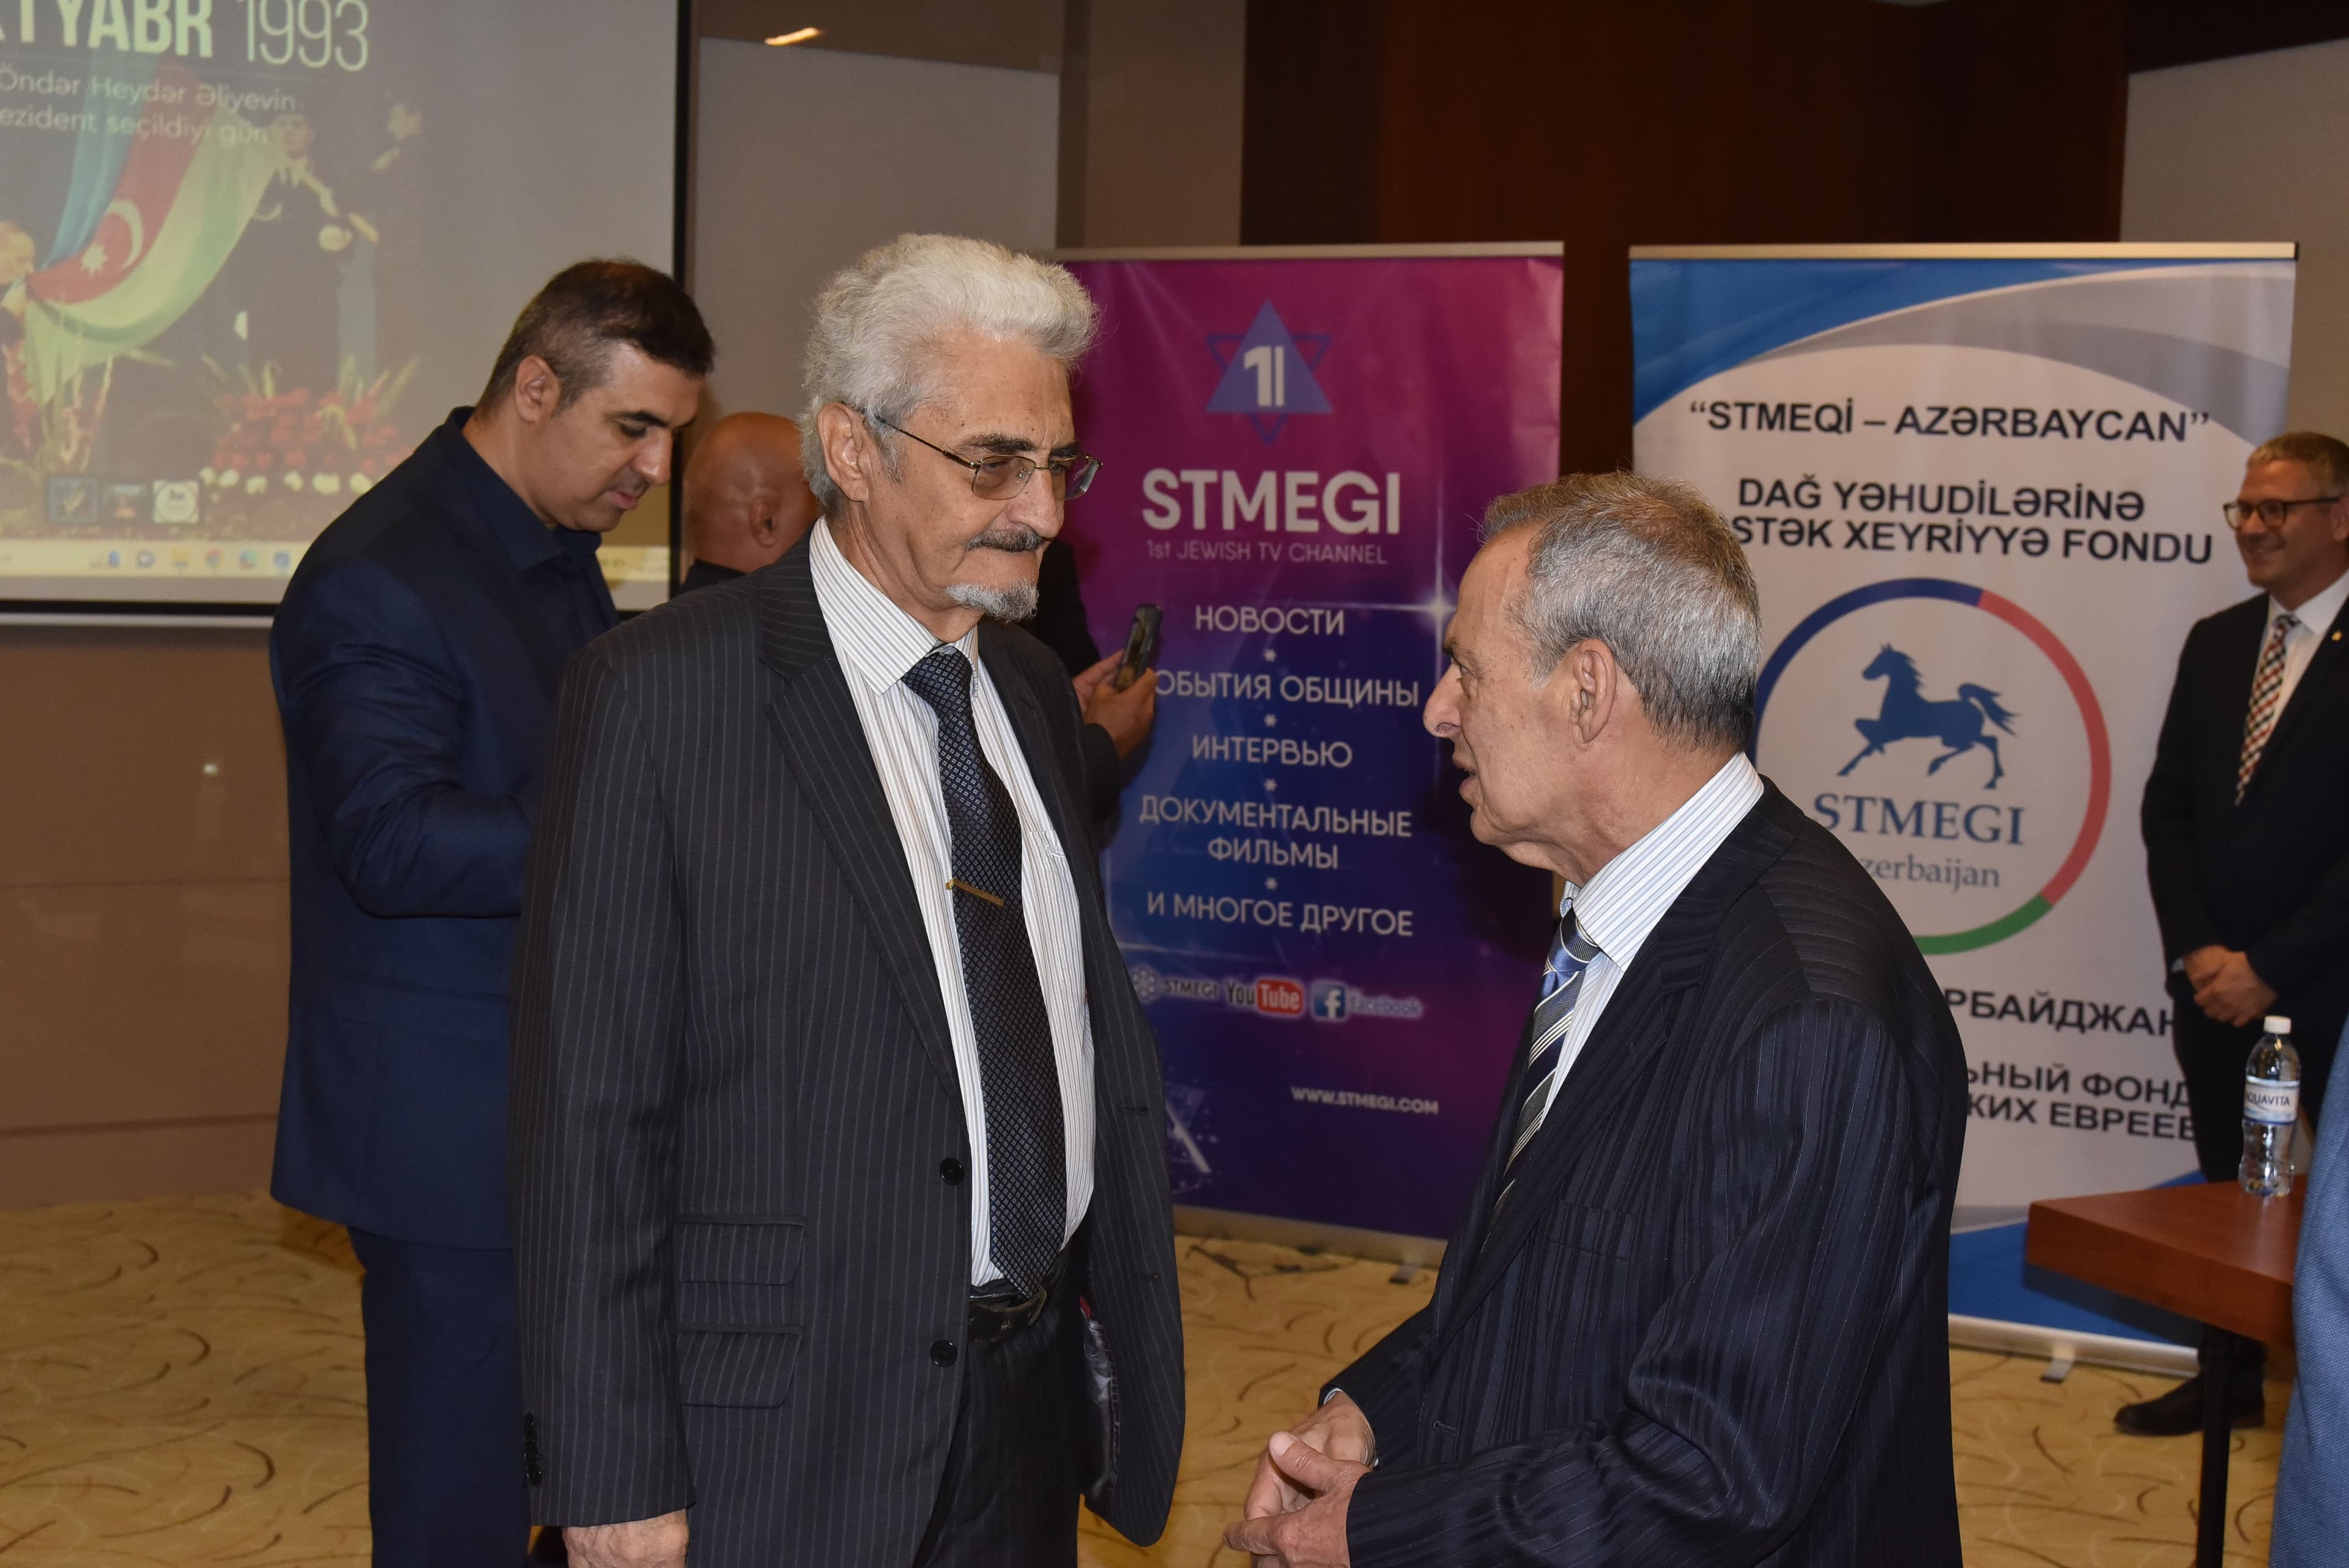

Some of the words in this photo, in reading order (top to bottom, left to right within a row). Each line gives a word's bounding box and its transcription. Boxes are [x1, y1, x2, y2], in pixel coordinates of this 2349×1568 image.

[237, 0, 368, 72] 1993
[1142, 468, 1401, 535] STMEGI
[1738, 473, 1822, 510] DAĞ
[1833, 480, 2145, 521] YƏHUDİLƏRİNƏ
[1147, 539, 1171, 559] 1st
[1176, 540, 1252, 561] JEWISH
[1258, 543, 1283, 561] TV
[1288, 543, 1387, 565] CHANNEL
[1843, 518, 2049, 558] XEYRİYYƏ
[2063, 528, 2213, 565] FONDU
[1195, 605, 1345, 636] НОВОСТИ
[1280, 675, 1419, 708] ОБЩИНЫ
[1192, 735, 1353, 768] ИНТЕРВЬЮ
[1138, 796, 1412, 838] ДОКУМЕНТАЛЬНЫЕ
[1814, 793, 2026, 845] STMEGI
[1208, 837, 1338, 870] ФИЛЬМЫ
[1147, 893, 1164, 915] И
[1173, 894, 1293, 927] МНОГОЕ
[1301, 904, 1413, 937] ДРУГОЕ
[1226, 980, 1301, 1011] YouTube
